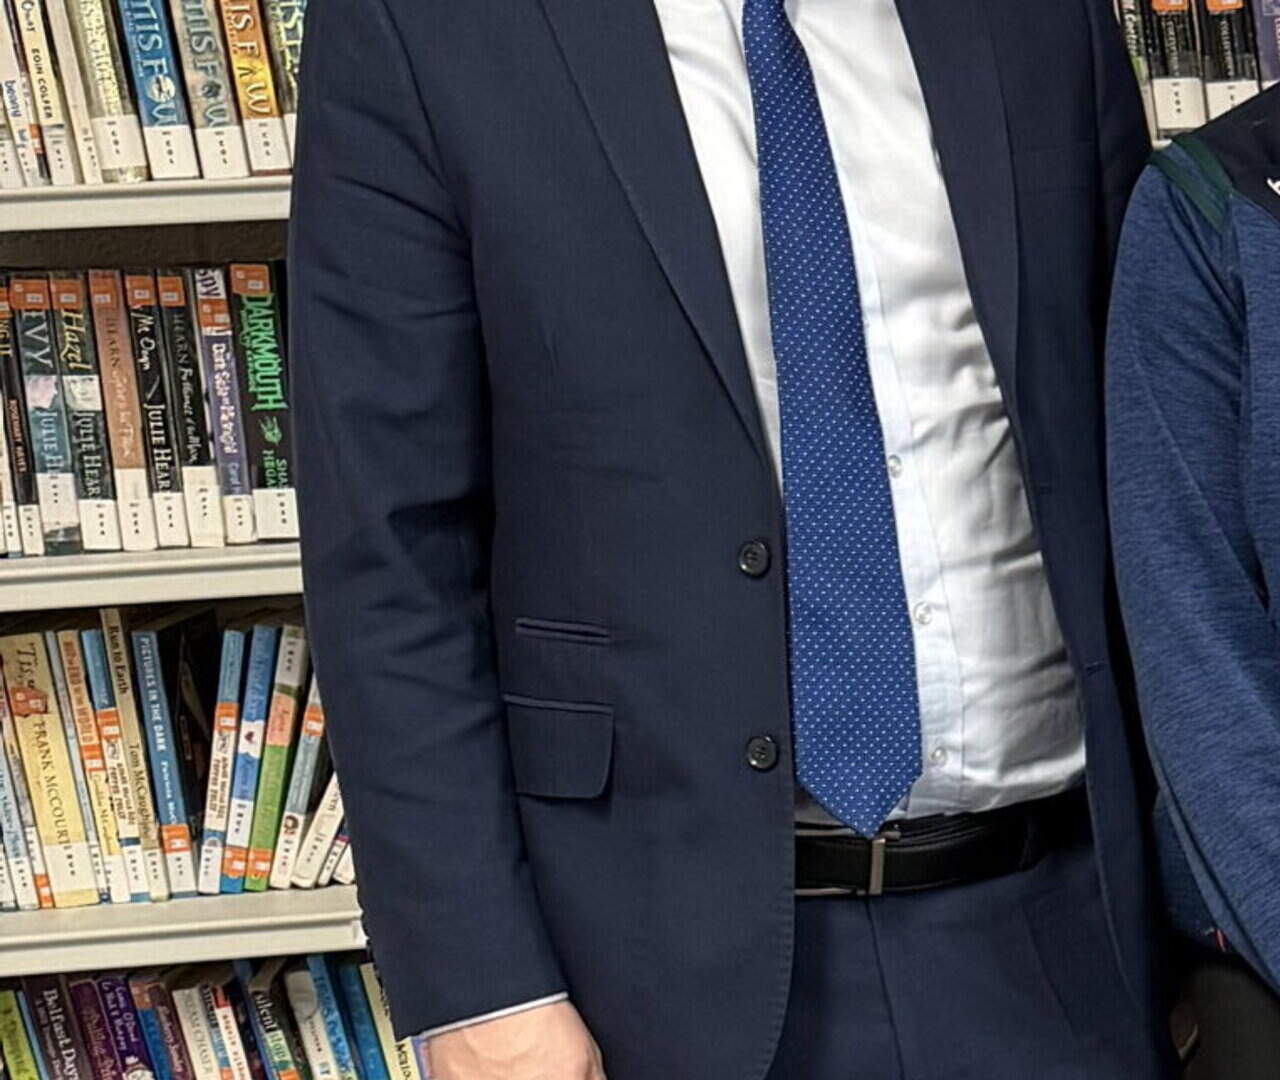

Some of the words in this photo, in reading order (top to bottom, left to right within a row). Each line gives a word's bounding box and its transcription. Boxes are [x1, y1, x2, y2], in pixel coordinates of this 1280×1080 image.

[31, 47, 44, 74] EOIN
[55, 308, 90, 372] Hazel
[239, 292, 285, 410] DARKMOUTH
[35, 408, 60, 451] JULIE
[76, 412, 98, 451] JULIE
[143, 401, 168, 446] JULIE
[82, 452, 103, 497] HEAR
[261, 449, 277, 488] HEGA
[108, 624, 121, 649] Run
[113, 650, 123, 663] to
[138, 636, 157, 687] PICTURES
[115, 664, 129, 694] Earth
[147, 688, 159, 702] IN
[149, 703, 162, 723] THE
[32, 720, 54, 772] FRANK
[128, 742, 142, 768] Tom
[152, 723, 167, 752] DARK
[41, 987, 72, 1050] Belfast
[253, 991, 277, 1031] silent
